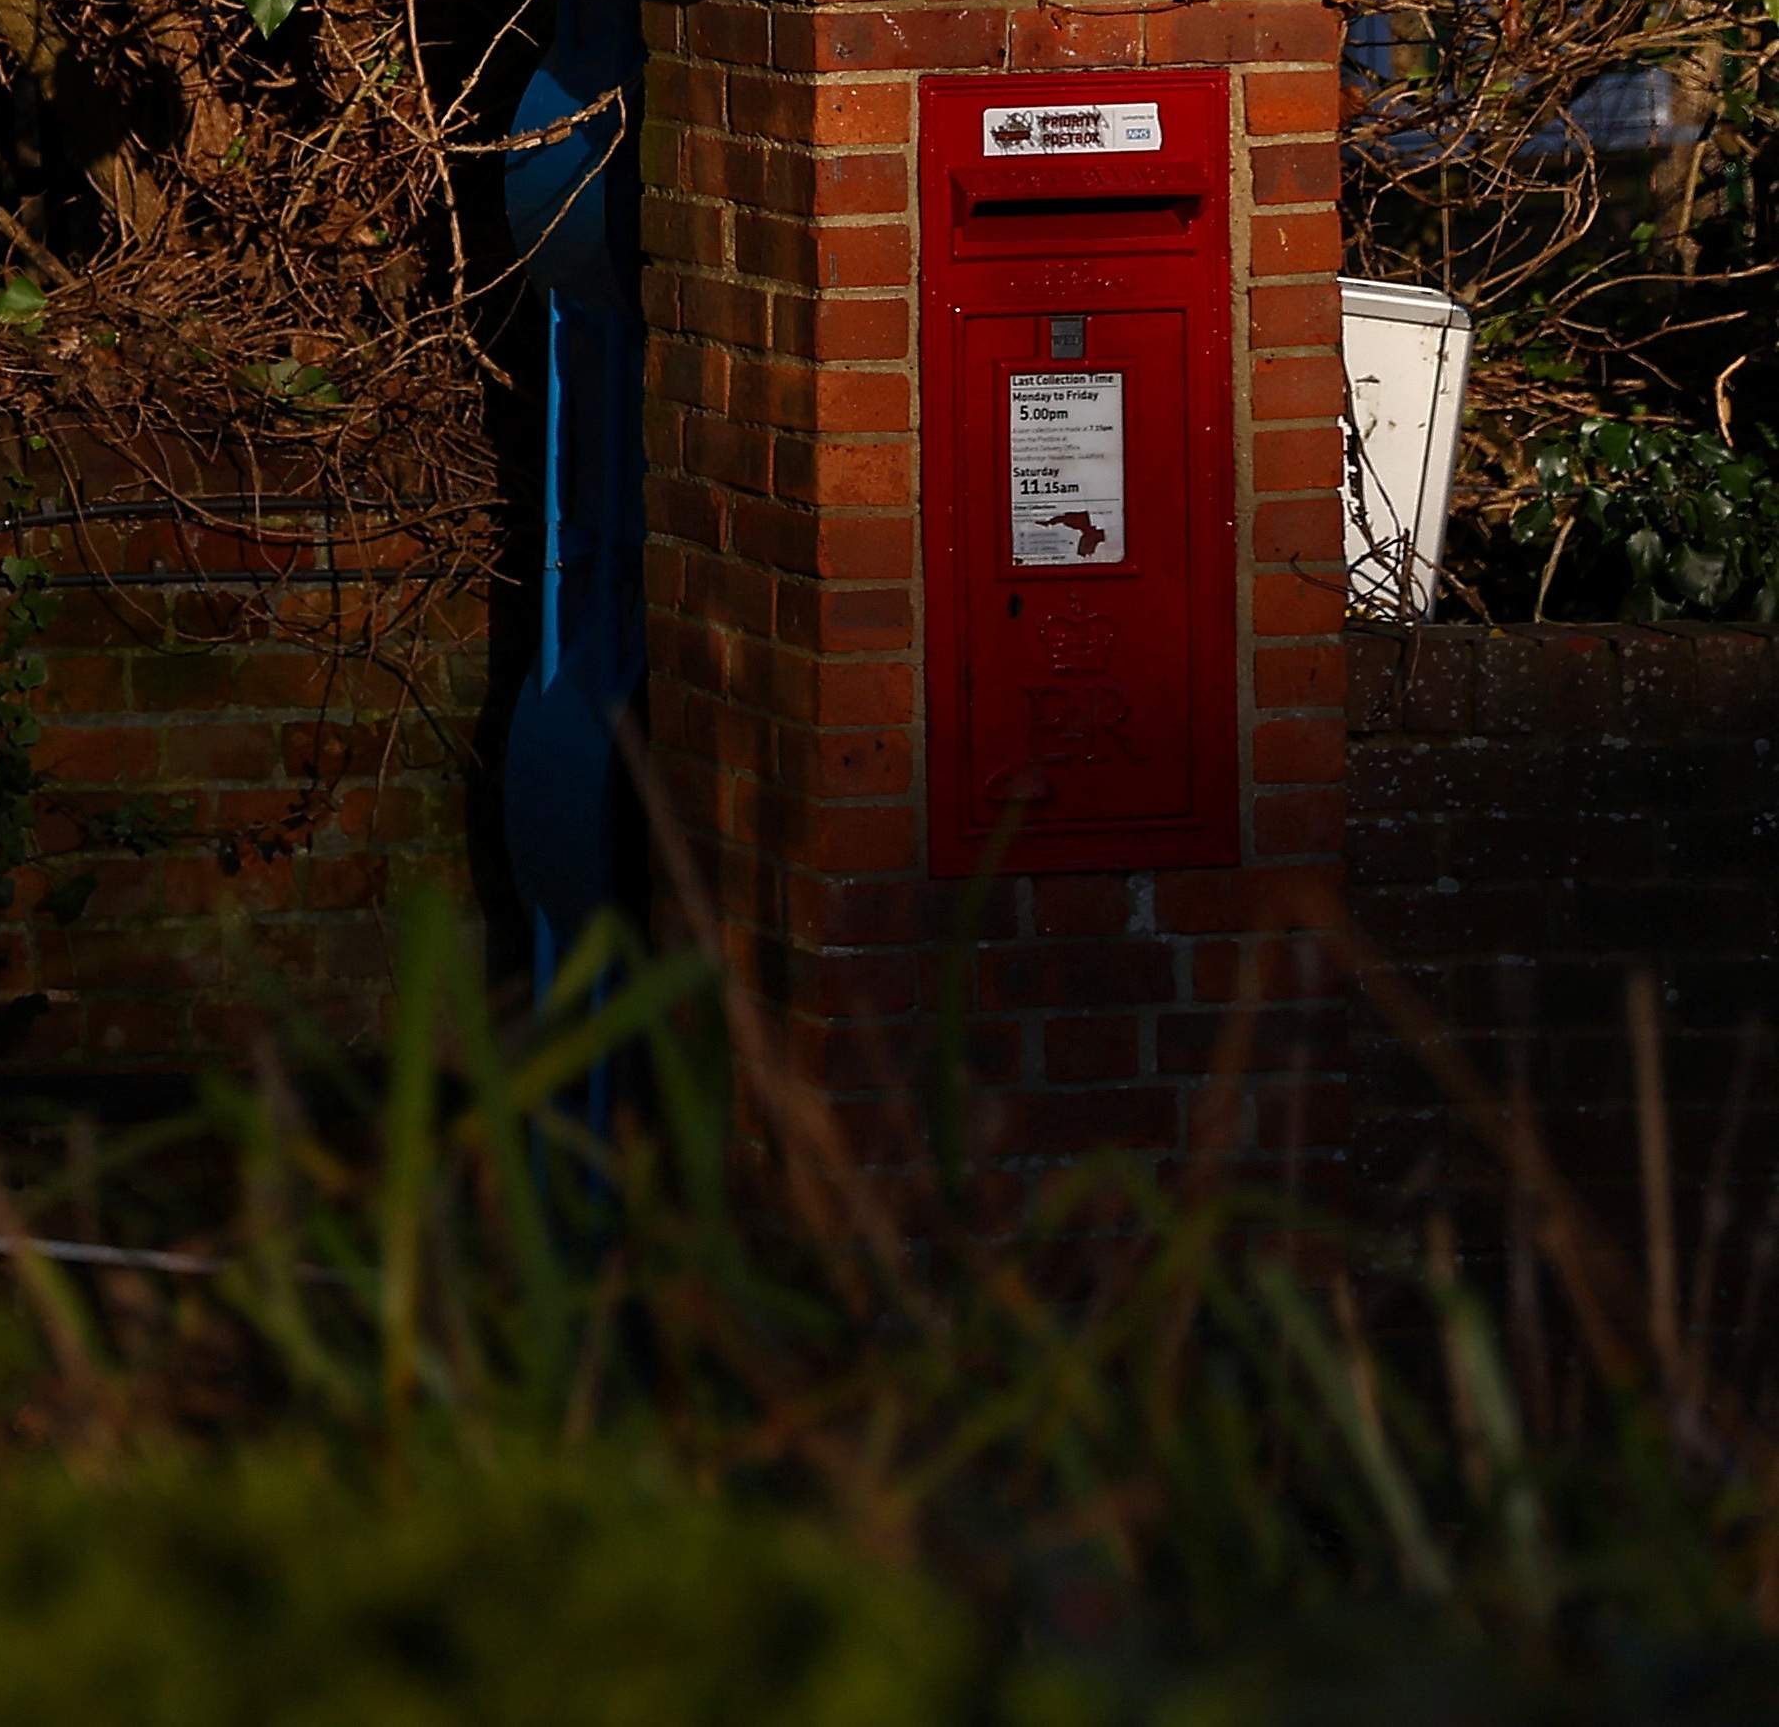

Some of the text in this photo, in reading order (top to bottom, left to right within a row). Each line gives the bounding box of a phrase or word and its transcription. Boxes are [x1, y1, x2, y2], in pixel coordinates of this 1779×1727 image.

[1042, 113, 1101, 129] PRIORITY
[1042, 132, 1101, 146] POSTBOX
[1013, 374, 1113, 387] Last Collection Time
[1013, 390, 1099, 403] Monday to Friday
[1020, 405, 1069, 421] 5.00pm
[1013, 467, 1059, 478] Saturday
[1021, 479, 1079, 494] 11.15am
